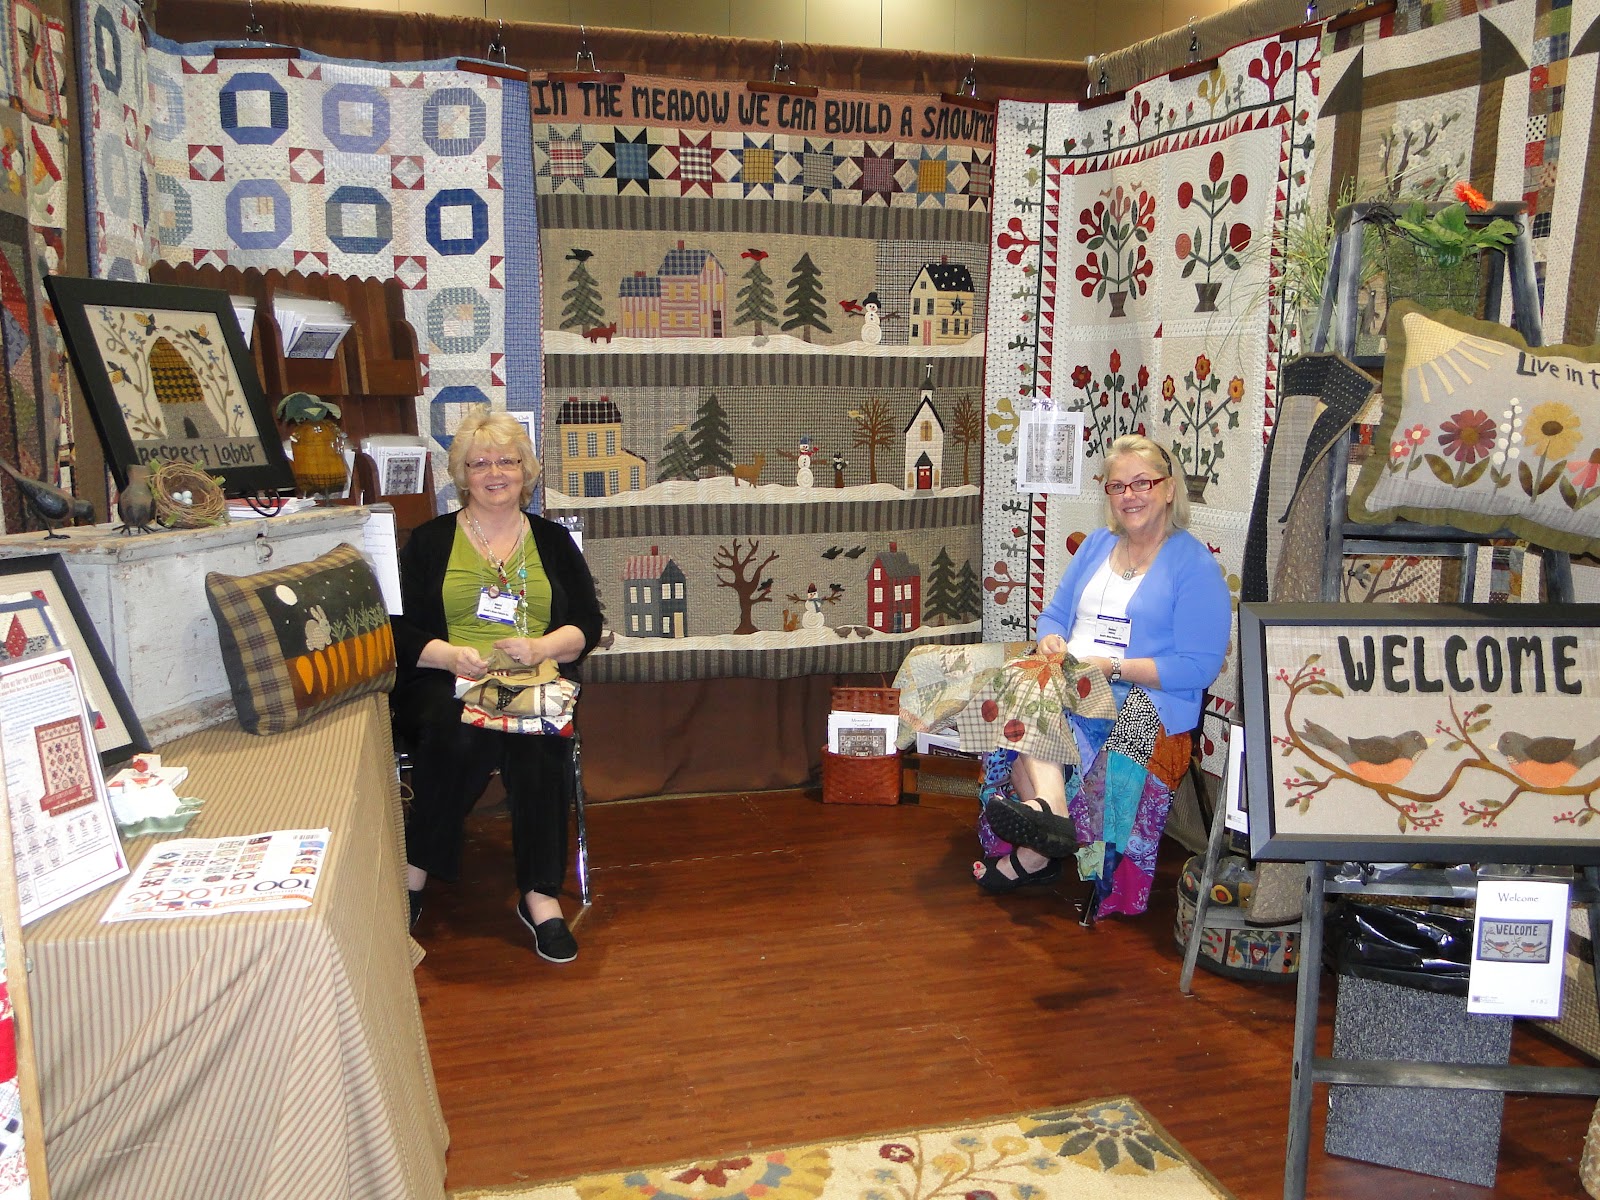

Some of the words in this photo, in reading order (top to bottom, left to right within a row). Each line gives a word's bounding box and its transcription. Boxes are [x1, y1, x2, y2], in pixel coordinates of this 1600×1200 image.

[532, 80, 567, 115] IN
[578, 82, 623, 117] THE
[632, 85, 730, 124] MEADOW
[738, 92, 770, 126] WE
[777, 95, 817, 130] CAN
[824, 100, 892, 135] BUILD
[900, 105, 914, 137] A
[1516, 351, 1559, 379] Live
[1565, 364, 1584, 386] in
[213, 442, 256, 466] Labor
[1338, 634, 1583, 695] WELCOME
[128, 883, 247, 902] BLOCKS
[254, 878, 312, 892] 100
[1498, 892, 1540, 902] Welcome
[1495, 924, 1538, 937] WELCOME
